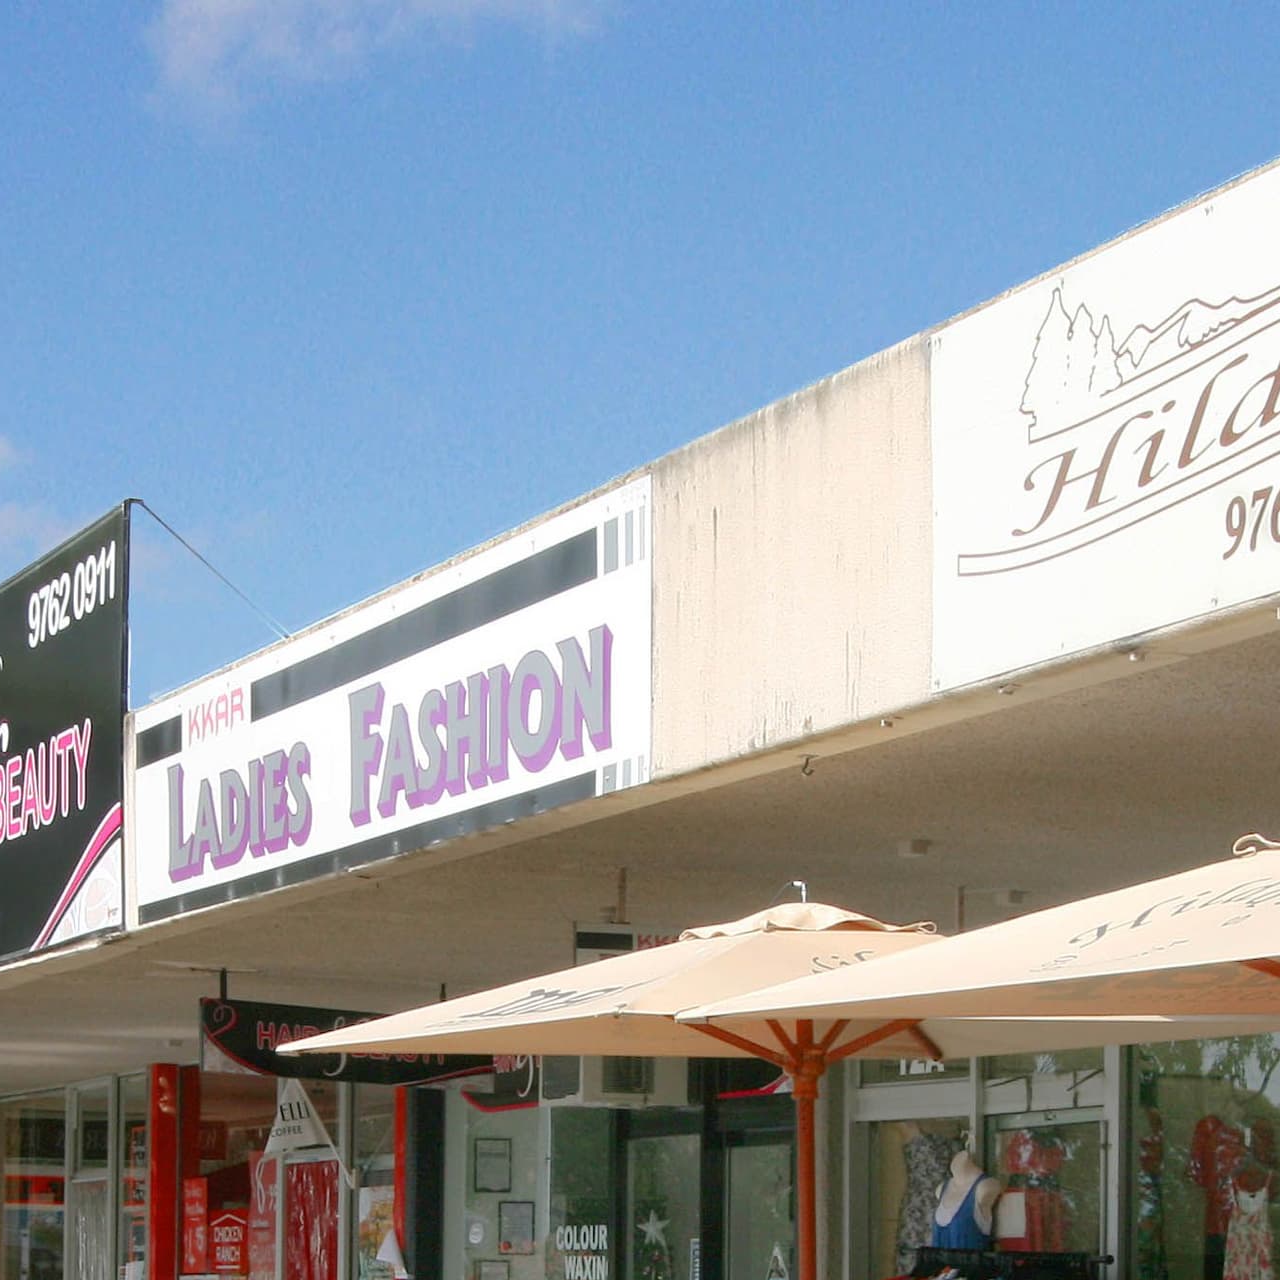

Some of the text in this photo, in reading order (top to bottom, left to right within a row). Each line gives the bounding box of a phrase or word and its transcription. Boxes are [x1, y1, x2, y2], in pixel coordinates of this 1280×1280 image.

[27, 540, 116, 648] 9762 0911
[188, 686, 246, 747] KKAR
[556, 1224, 608, 1250] COLOUR
[564, 1255, 609, 1280] WAXIN
